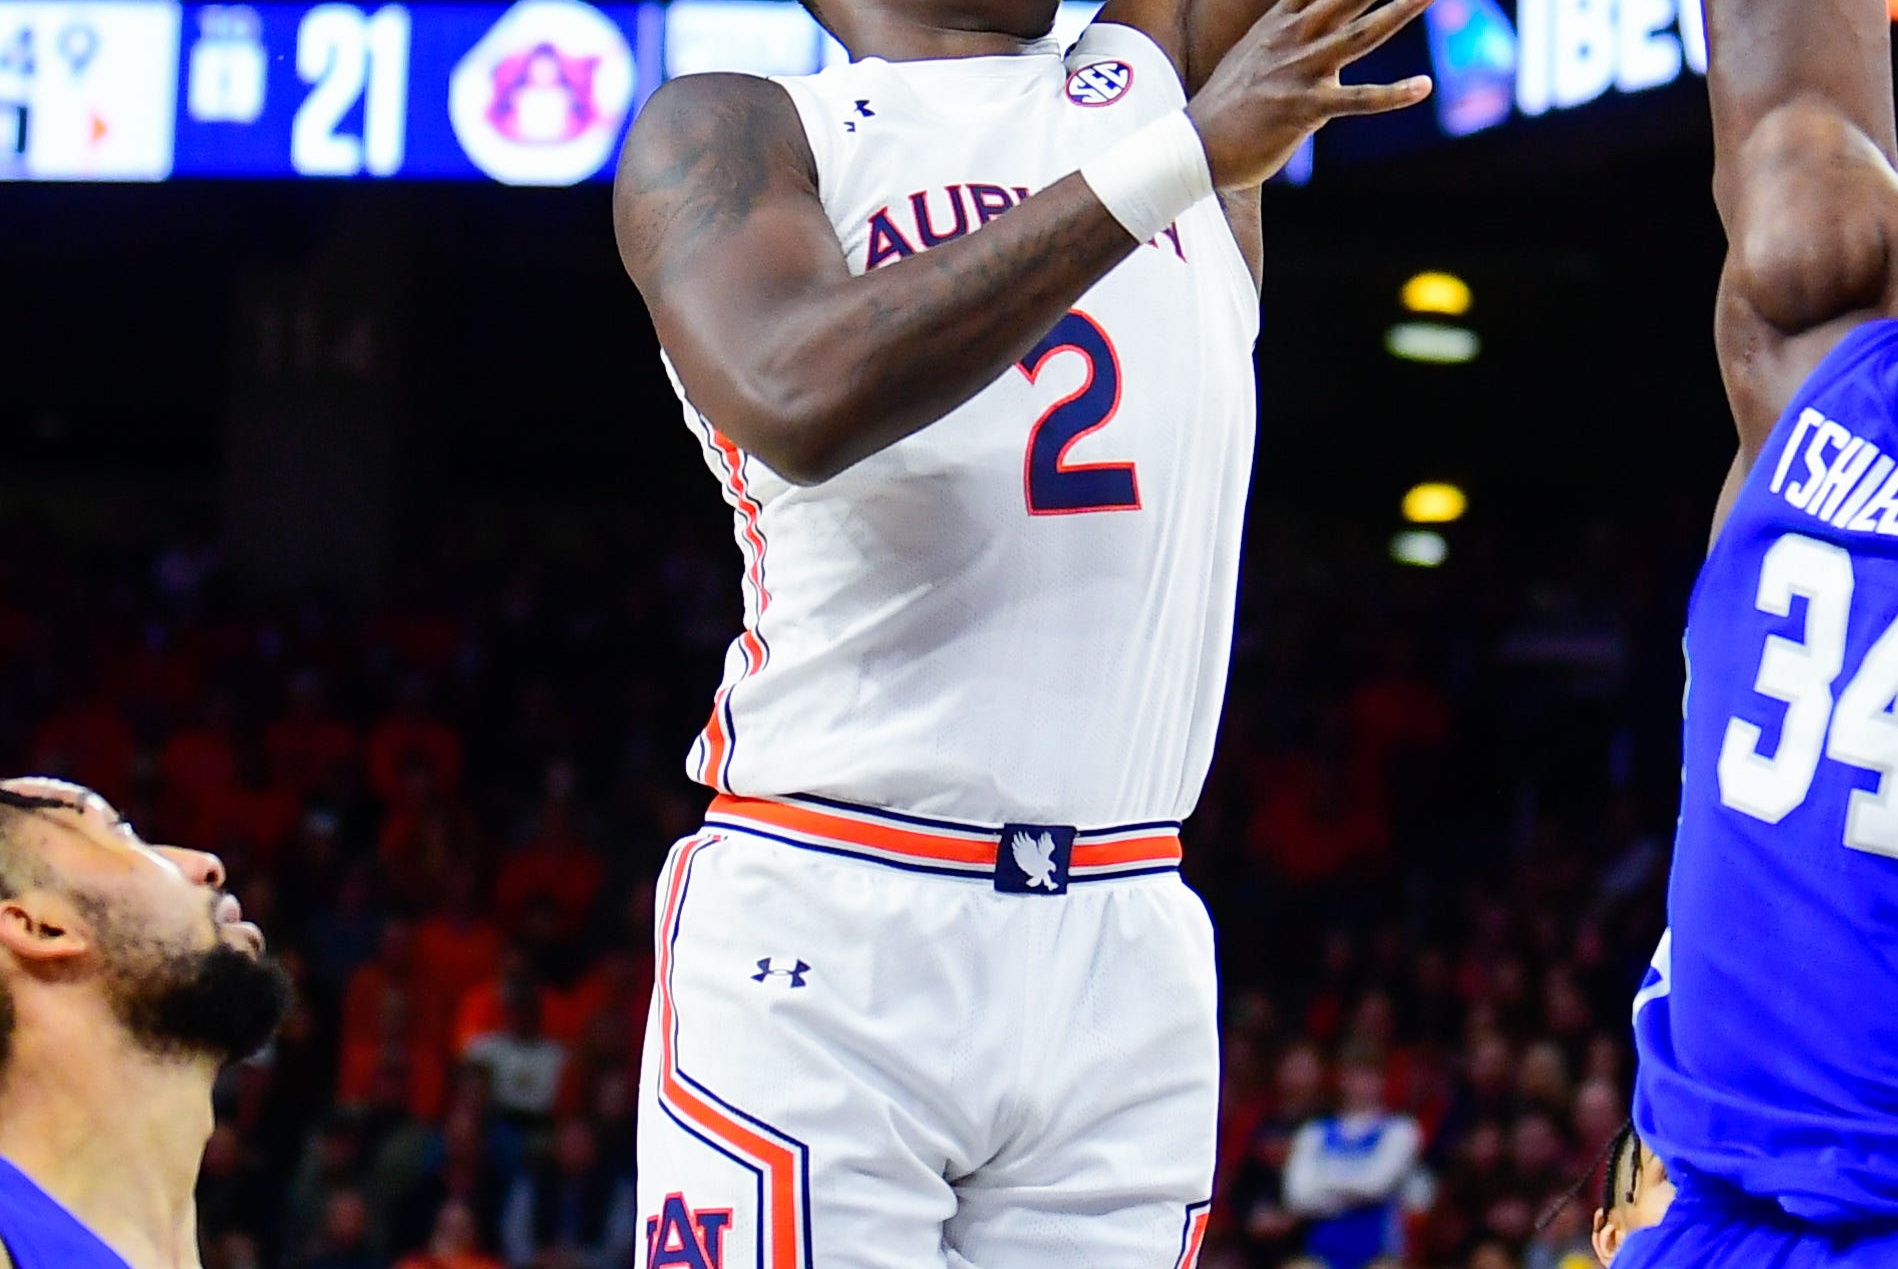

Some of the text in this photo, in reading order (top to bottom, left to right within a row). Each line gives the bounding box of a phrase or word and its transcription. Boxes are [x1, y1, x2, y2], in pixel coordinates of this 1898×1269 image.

[291, 2, 411, 178] 21
[1068, 62, 1129, 104] SEC
[1014, 307, 1142, 516] 2
